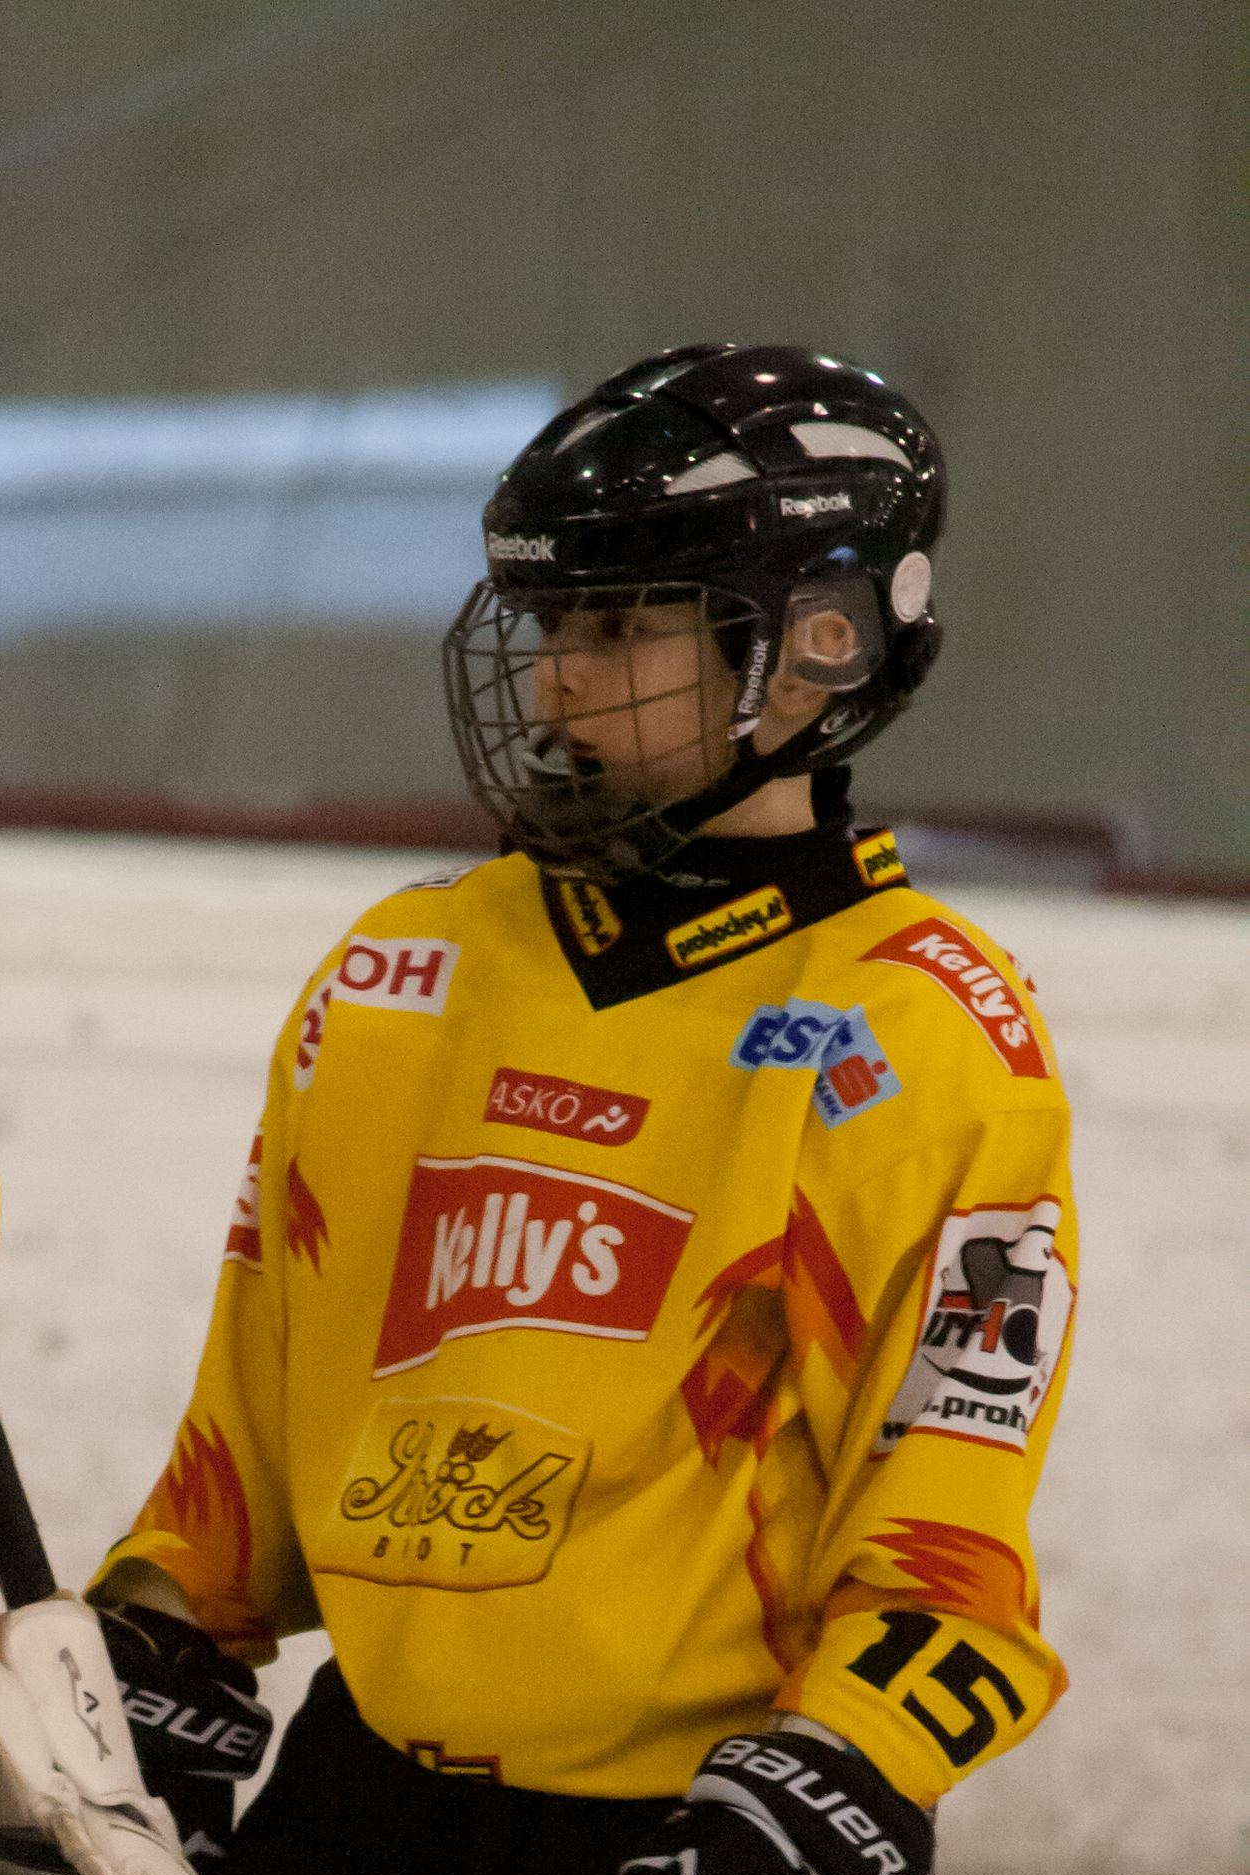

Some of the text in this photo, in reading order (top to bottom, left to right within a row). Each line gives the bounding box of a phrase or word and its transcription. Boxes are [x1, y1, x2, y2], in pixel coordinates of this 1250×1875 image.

[780, 493, 852, 517] Reebok
[488, 531, 556, 562] Reebok
[738, 640, 770, 715] Reebok
[906, 933, 1029, 1048] Kelly's
[490, 1081, 581, 1125] ASKÖ
[424, 1192, 626, 1311] Kelly's
[845, 1611, 1027, 1768] 15
